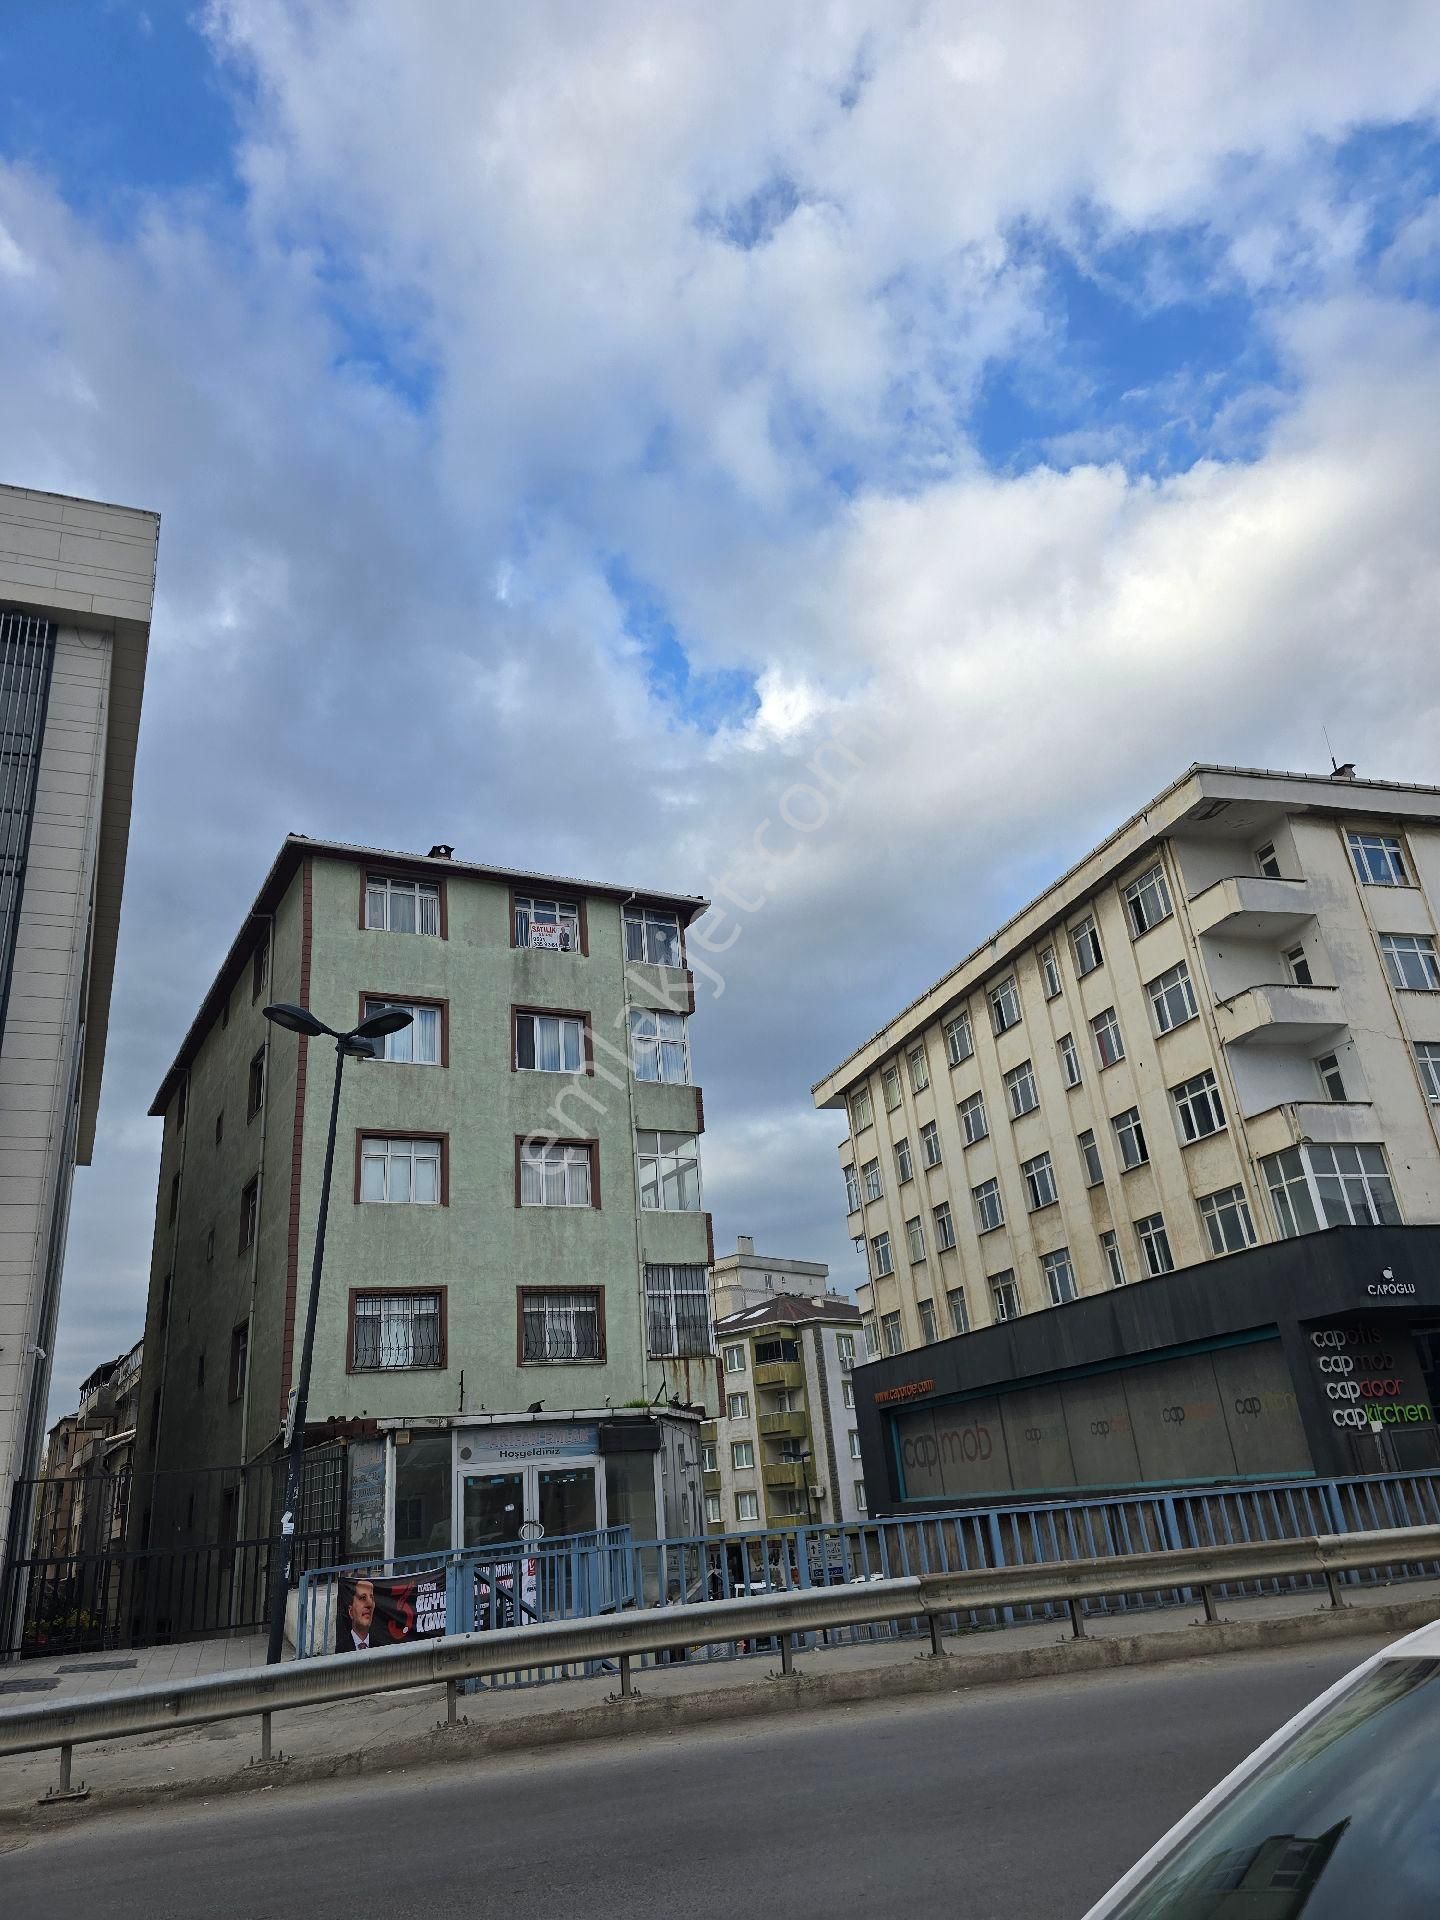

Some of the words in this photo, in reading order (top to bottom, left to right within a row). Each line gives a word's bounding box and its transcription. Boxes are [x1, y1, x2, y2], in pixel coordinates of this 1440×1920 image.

[1326, 1377, 1403, 1403] capdoor
[1332, 1402, 1431, 1430] capkitchen
[499, 1447, 561, 1459] Hoşgeldiniz
[416, 1590, 447, 1613] BÜYÜ
